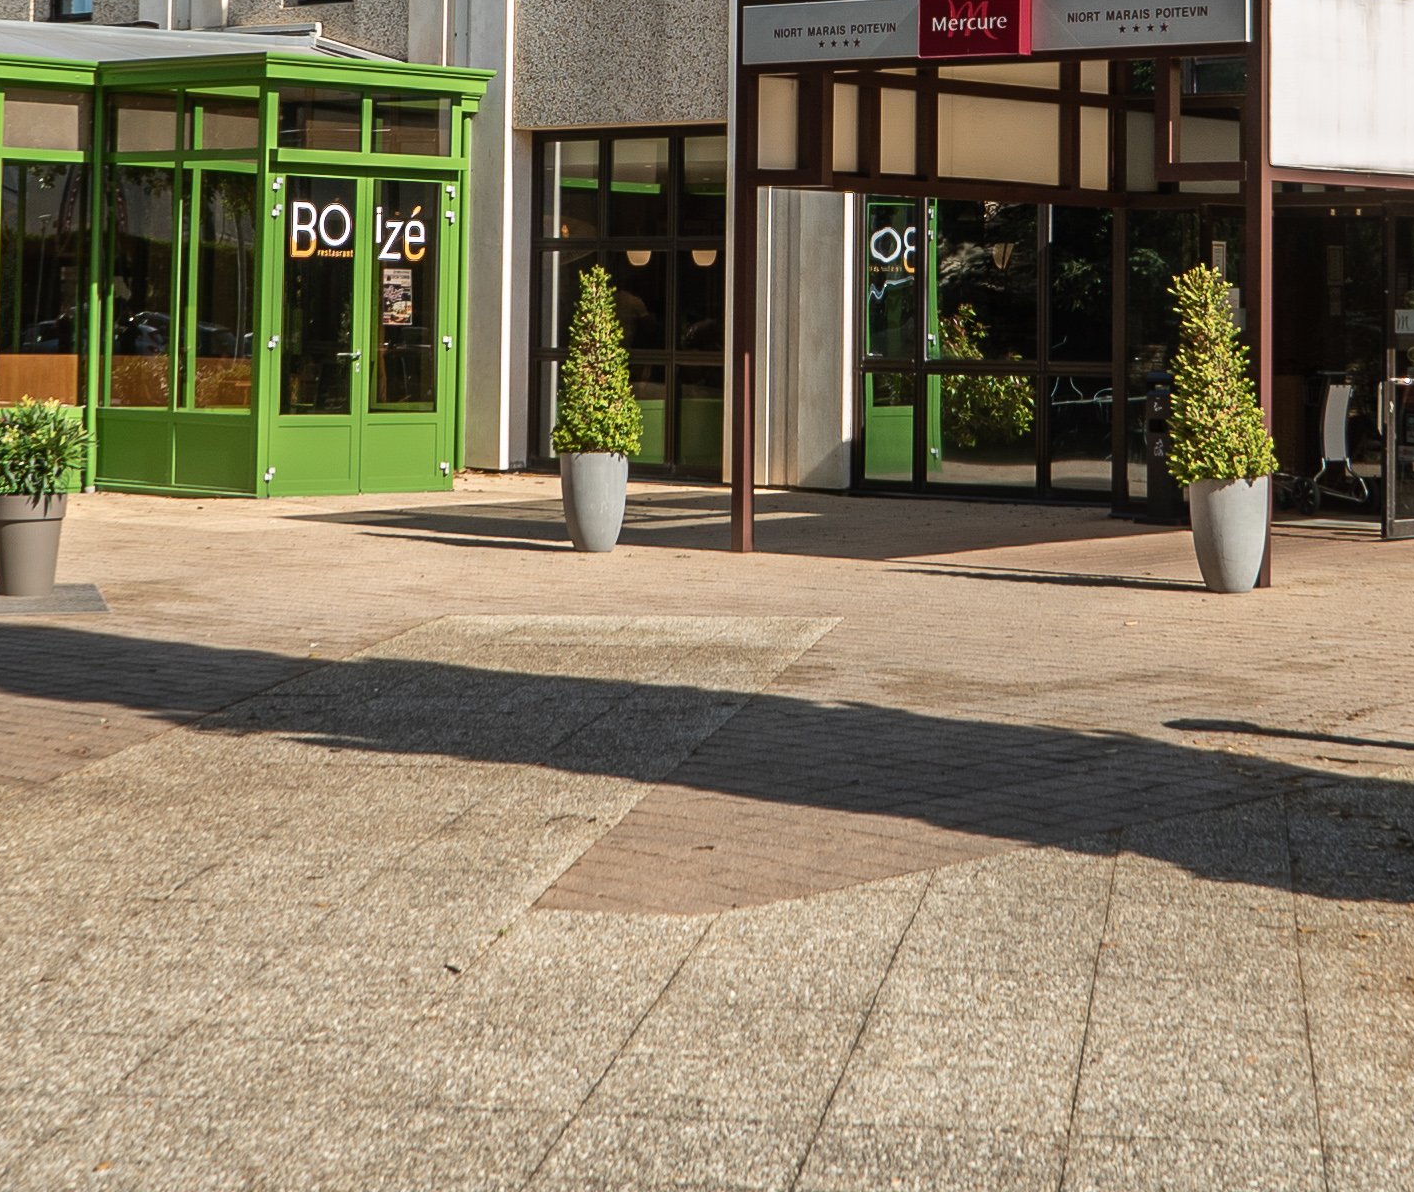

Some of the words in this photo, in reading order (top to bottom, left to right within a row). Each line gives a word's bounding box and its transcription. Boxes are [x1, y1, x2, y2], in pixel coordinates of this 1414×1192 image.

[1067, 11, 1101, 23] NIORT
[1106, 8, 1150, 21] MARAIS
[1155, 6, 1208, 19] POITEVIN
[773, 27, 803, 39] NIORT
[807, 25, 846, 37] MARAIS
[850, 22, 897, 35] POITEVIN
[932, 15, 1007, 32] Mercure
